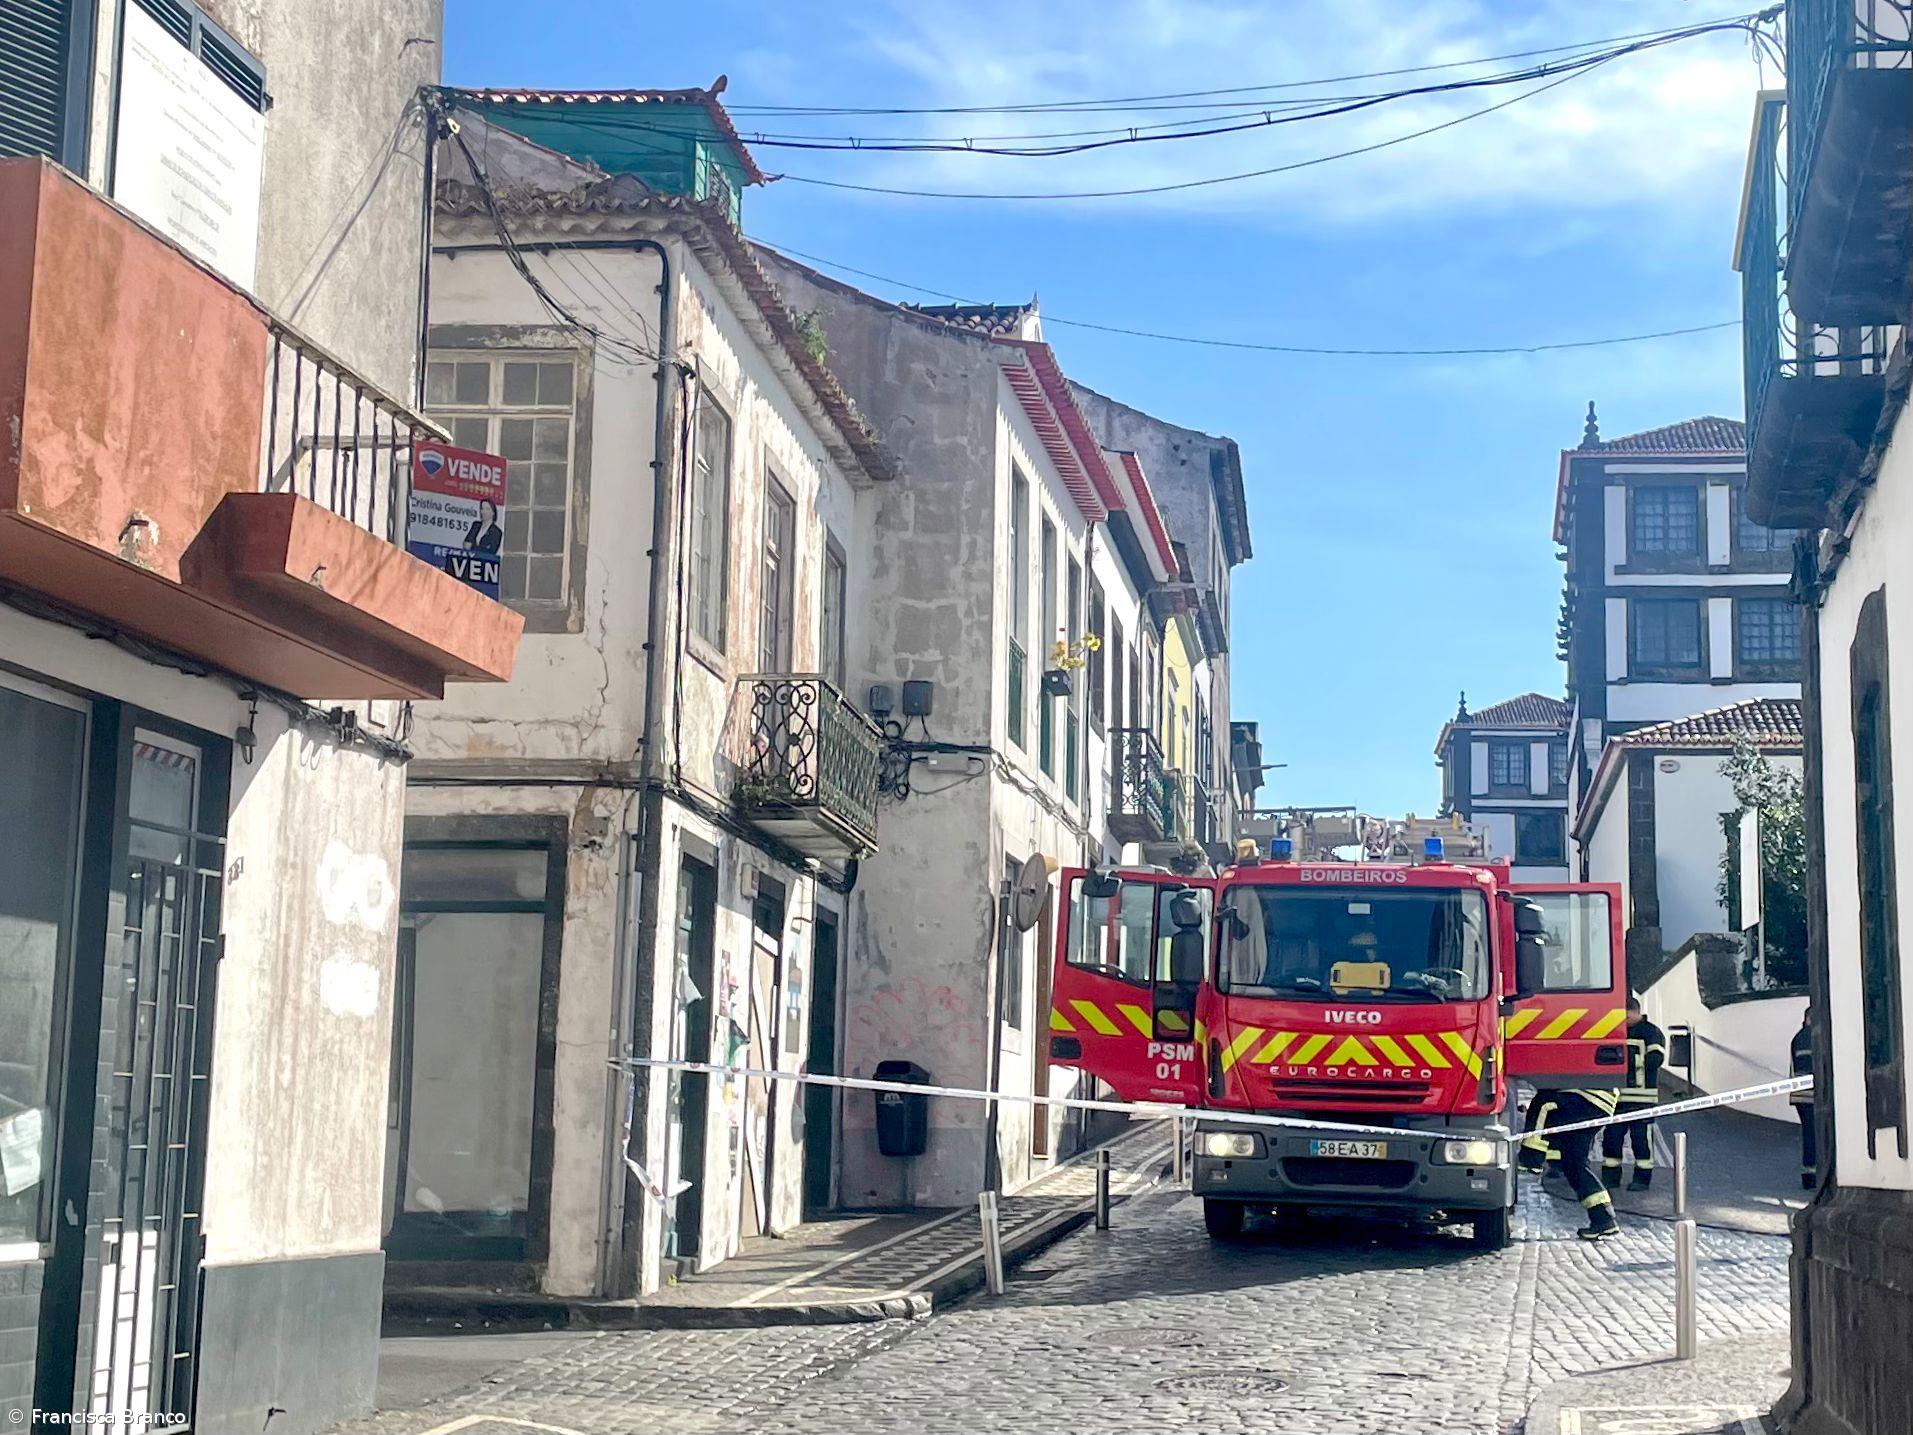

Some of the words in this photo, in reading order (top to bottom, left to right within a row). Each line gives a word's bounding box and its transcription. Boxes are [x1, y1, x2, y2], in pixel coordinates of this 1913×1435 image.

[447, 457, 502, 486] VENDE
[444, 503, 478, 518] Gouveia
[410, 512, 469, 532] 918481635
[452, 557, 499, 583] VEN
[1301, 869, 1407, 884] BOMBEIROS
[1324, 1010, 1382, 1024] IVECO
[1147, 1042, 1195, 1062] PSM
[1156, 1062, 1180, 1080] 01
[1269, 1066, 1432, 1079] EUROCARGO
